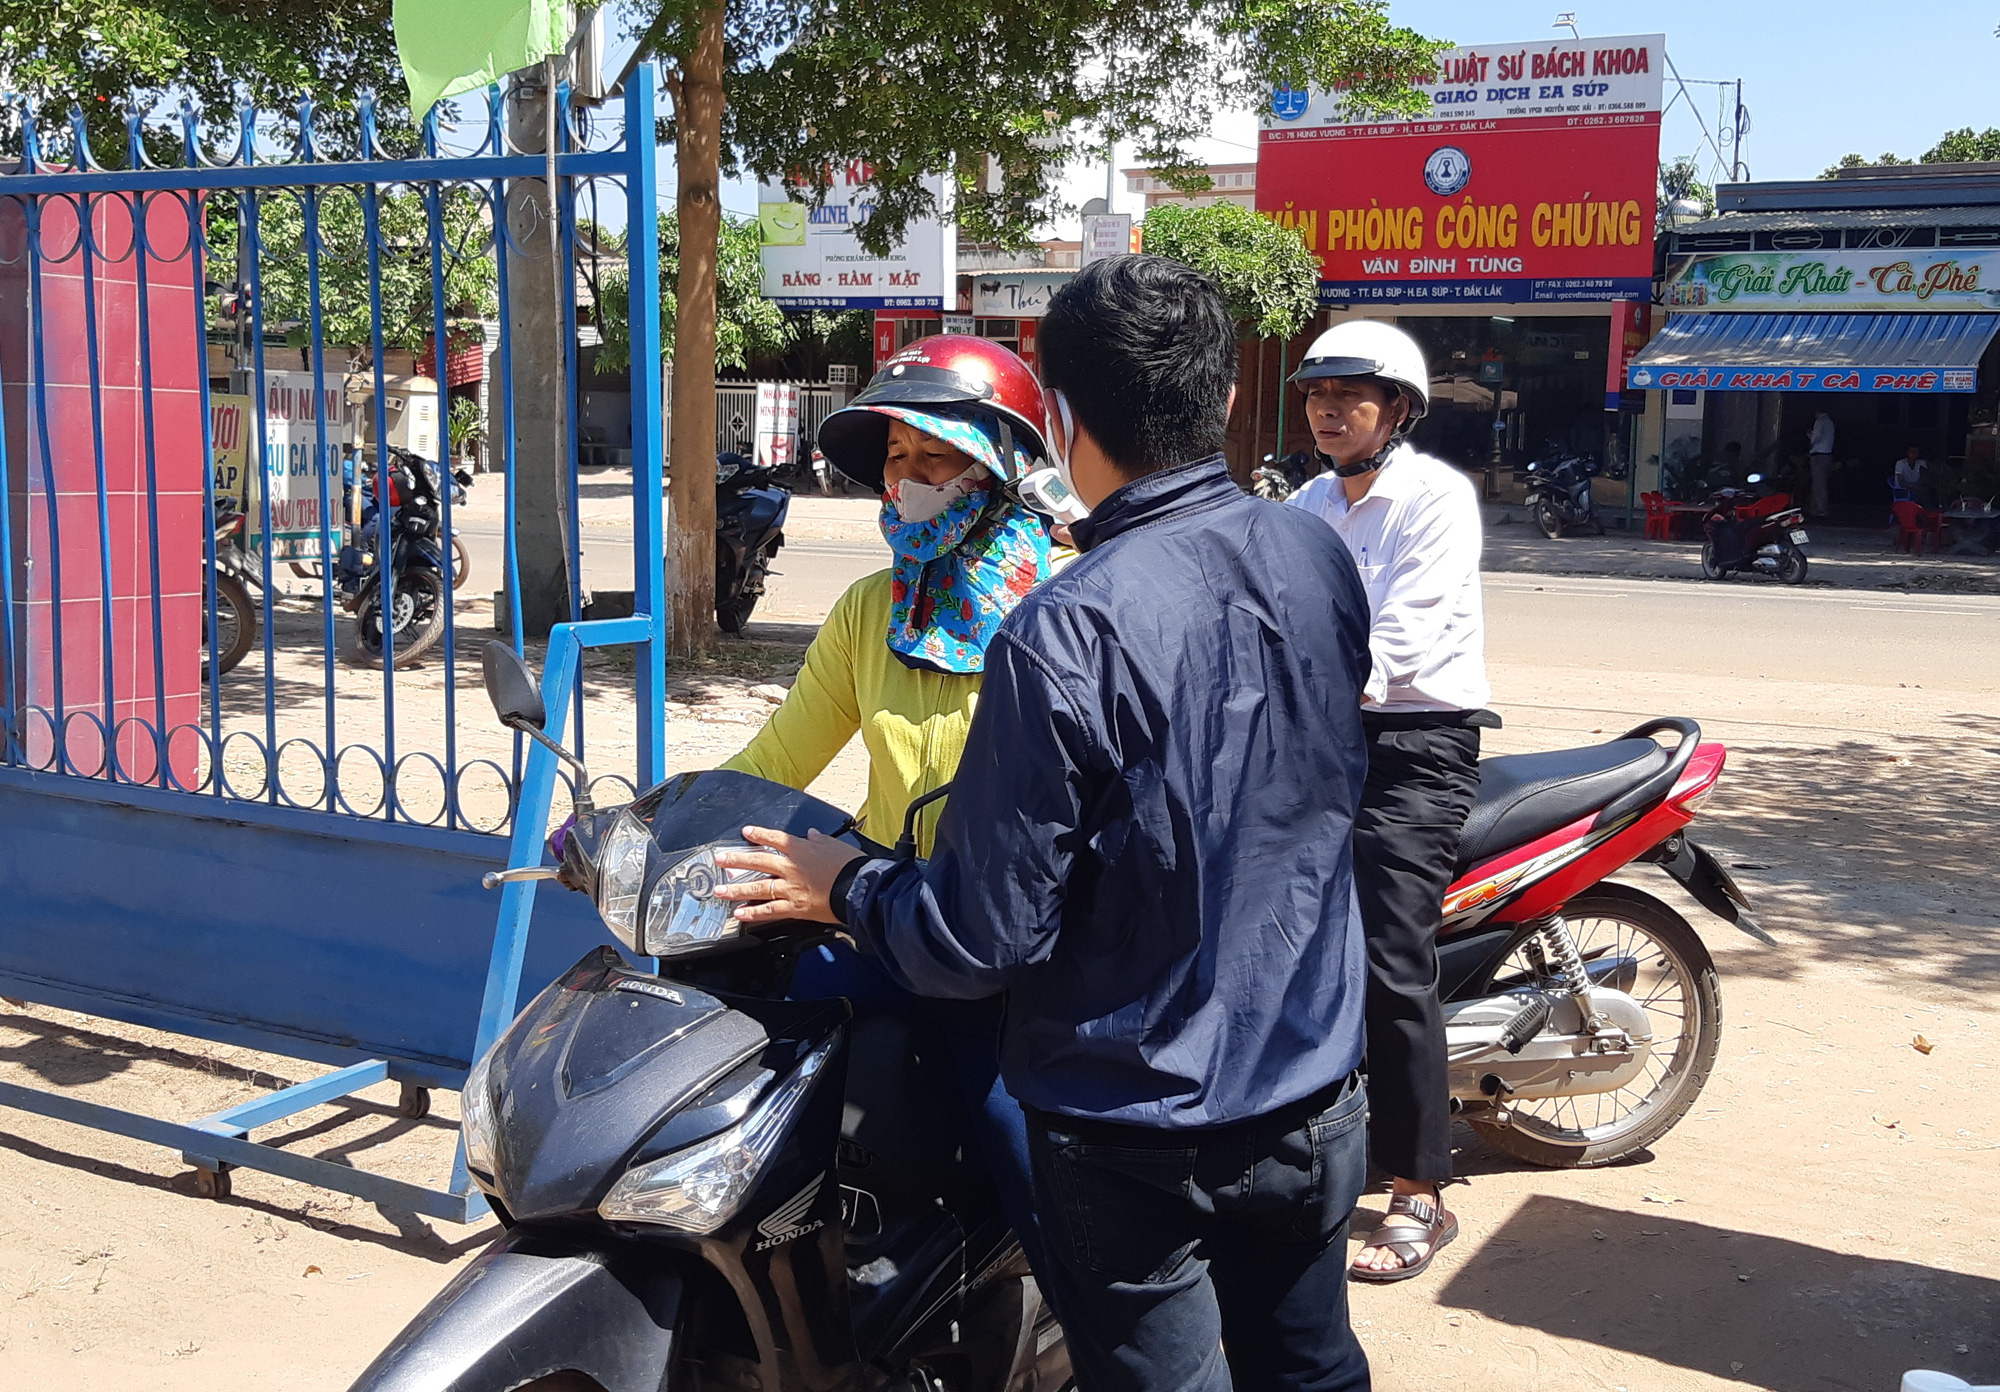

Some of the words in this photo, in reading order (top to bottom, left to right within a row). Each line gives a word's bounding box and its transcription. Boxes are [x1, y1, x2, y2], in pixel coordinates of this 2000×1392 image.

[1444, 51, 1489, 86] LUẬT
[1497, 48, 1527, 81] SƯ
[1531, 46, 1585, 79] BÁCH
[1593, 47, 1649, 76] KHOA
[1434, 89, 1478, 104] GIAO
[1486, 86, 1531, 104] DỊCH
[1538, 85, 1565, 99] EA
[1572, 79, 1609, 97] SÚP
[811, 205, 849, 224] MINH
[1327, 198, 1424, 251] PHÒNG
[1436, 195, 1518, 249] CÔNG
[1531, 191, 1641, 248] CHỨNG
[782, 271, 821, 287] RĂNG
[838, 269, 873, 286] HÀM
[888, 269, 921, 289] MẶT
[1361, 256, 1399, 274] VĂN
[1409, 255, 1456, 274] ĐÌNH
[1467, 254, 1523, 273] TÙNG
[1708, 262, 1775, 301] Giải
[1778, 262, 1853, 295] Khát
[1868, 261, 1914, 294] Cà
[1916, 259, 1982, 300] Phê
[1004, 279, 1043, 310] Thú
[1371, 287, 1383, 298] EA
[1658, 367, 1722, 388] GIẢI
[1729, 370, 1817, 388] KHÁT
[1821, 371, 1860, 389] CÀ
[1873, 371, 1939, 390] PHÊ
[265, 376, 293, 420] ẨU
[211, 403, 240, 450] ƯƠI
[260, 429, 285, 477] ẨU
[289, 436, 309, 477] CÁ
[213, 455, 238, 490] ẤP
[298, 498, 337, 527] THI
[755, 1217, 826, 1252] HONDA
